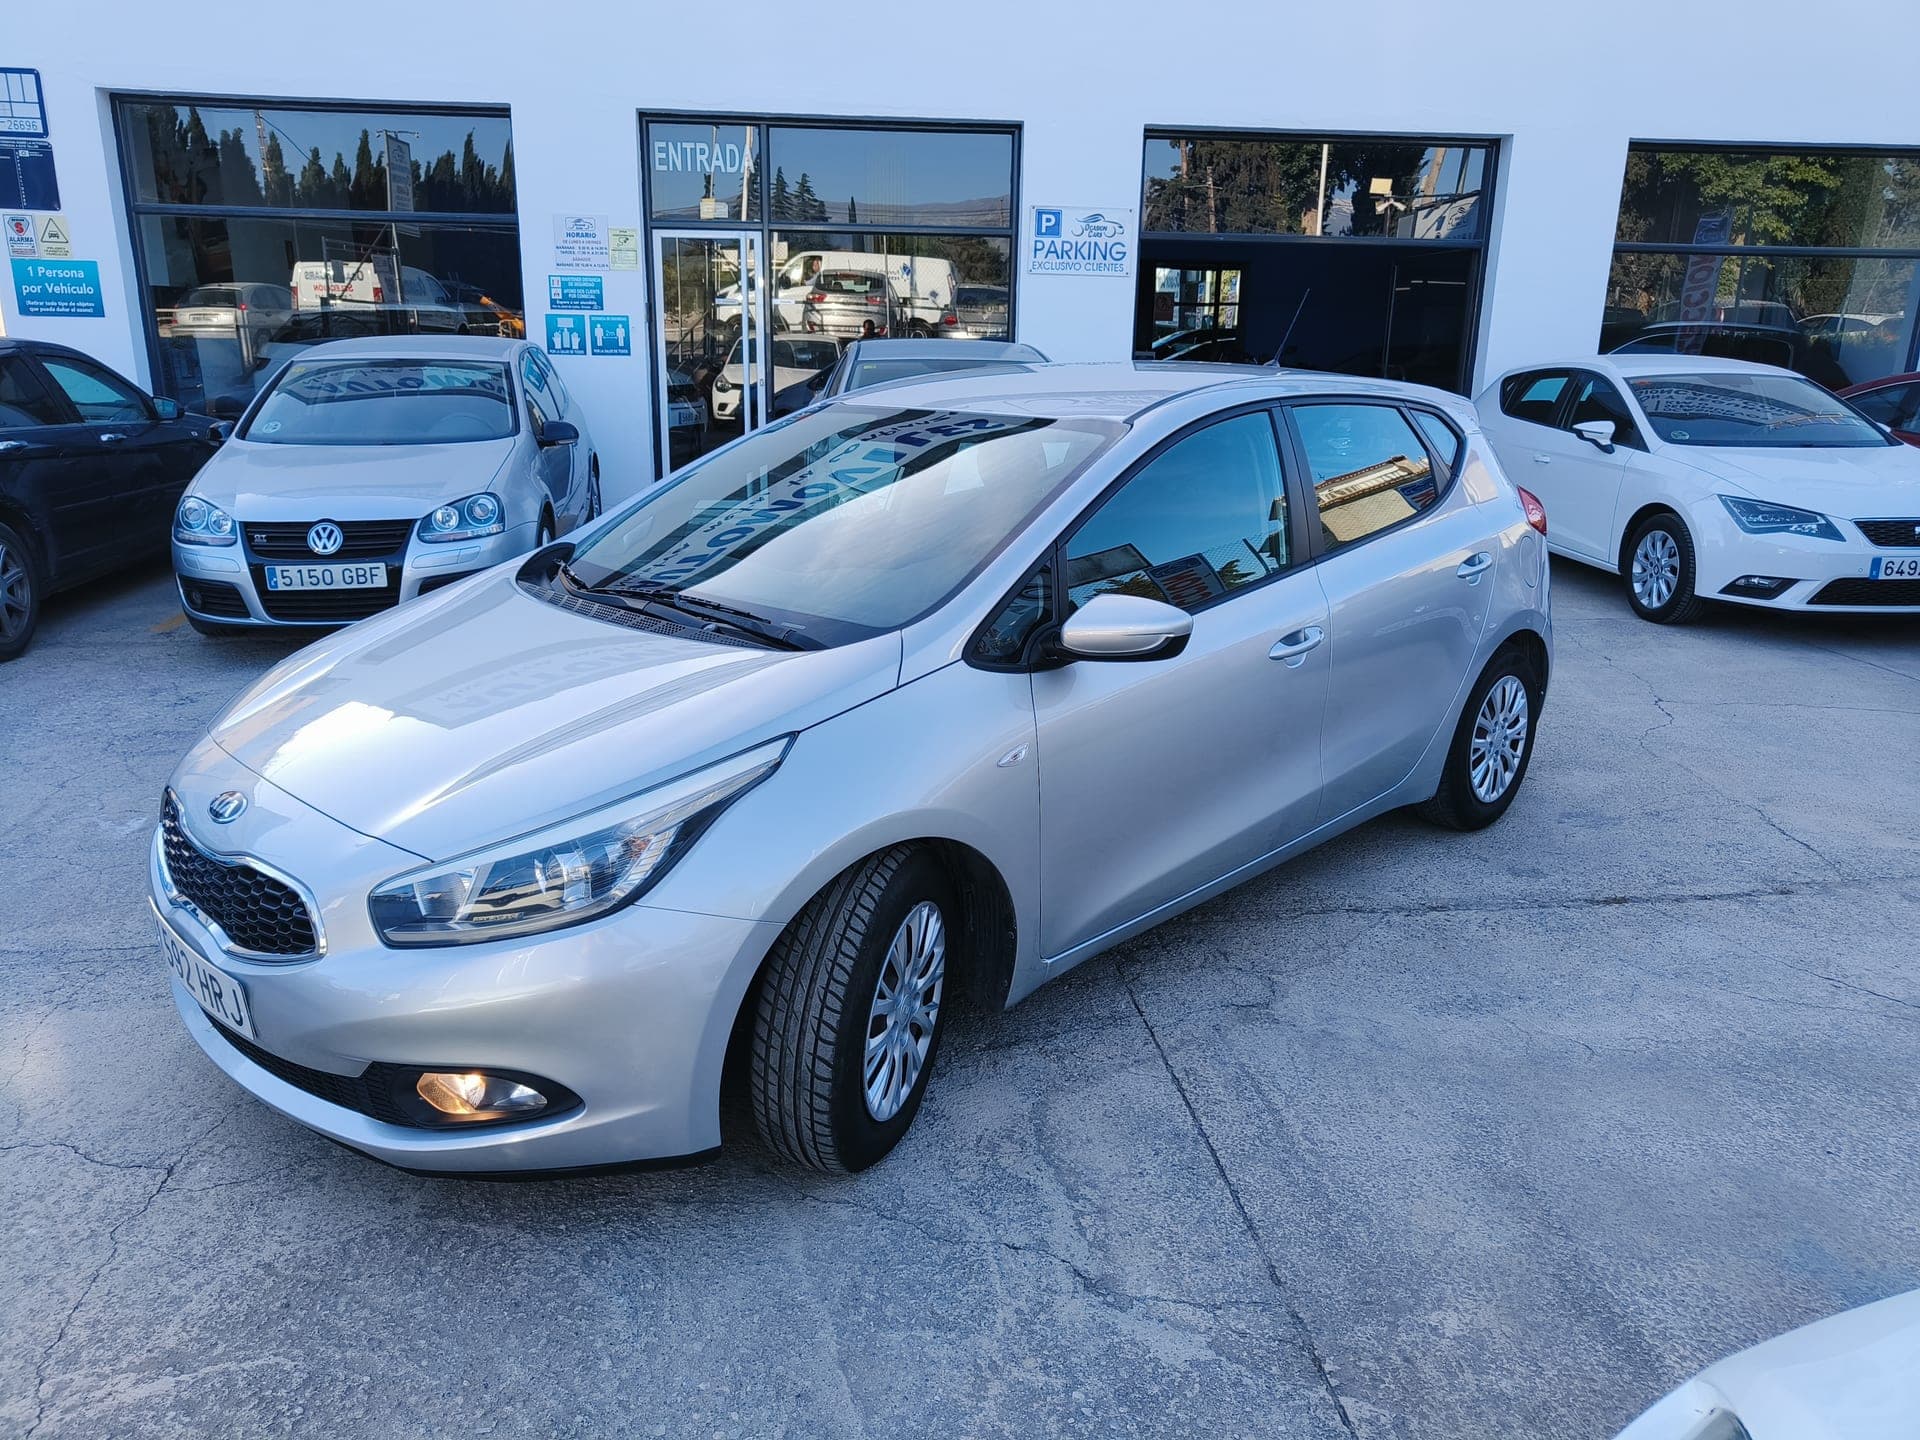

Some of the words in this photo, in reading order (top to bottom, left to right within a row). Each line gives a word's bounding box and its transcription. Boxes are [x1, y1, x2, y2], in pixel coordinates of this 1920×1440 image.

[654, 141, 755, 173] ENTRADA
[1041, 214, 1056, 233] P
[1033, 240, 1127, 261] PARKING
[27, 266, 33, 277] 1
[38, 267, 84, 278] Persona
[1032, 261, 1082, 271] EXCLUSIVO
[1084, 263, 1124, 272] CLIENTES
[22, 285, 42, 296] por
[280, 569, 334, 587] 5150
[342, 566, 381, 585] GBF
[1884, 560, 1920, 577] 649
[195, 963, 244, 1026] HRJ
